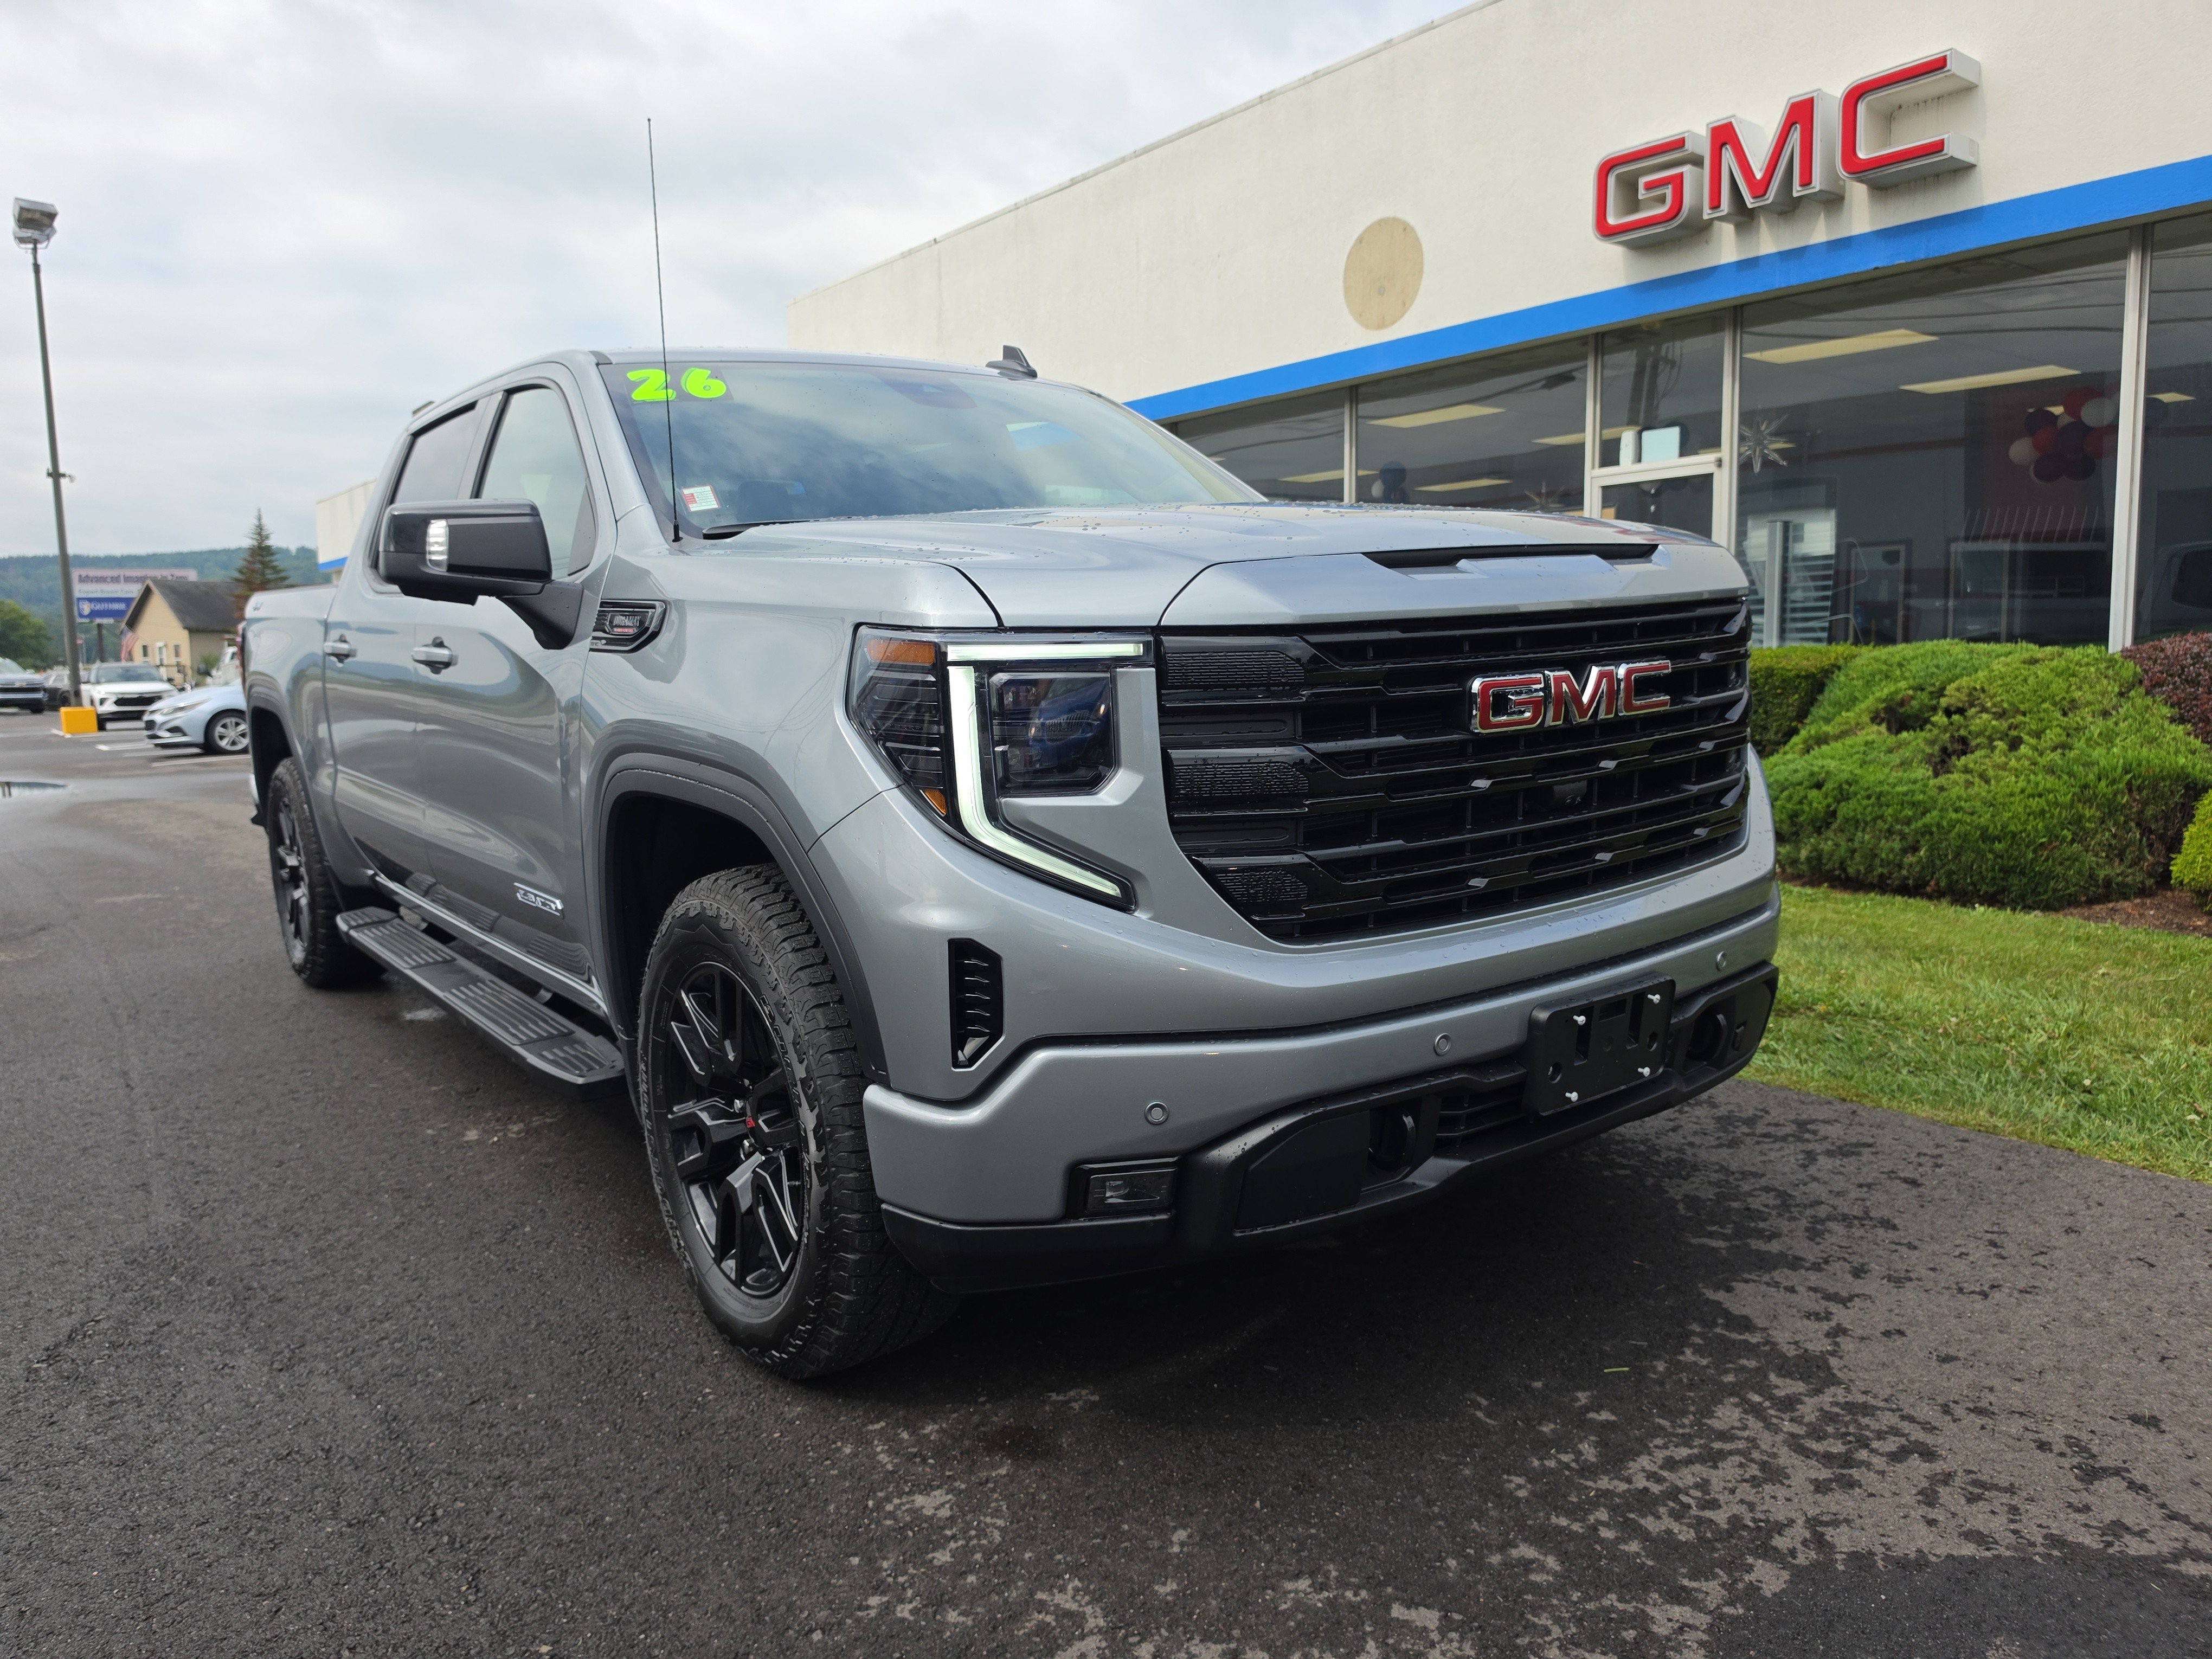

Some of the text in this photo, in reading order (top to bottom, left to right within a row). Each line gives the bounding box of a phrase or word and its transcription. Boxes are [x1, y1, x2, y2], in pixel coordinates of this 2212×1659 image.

[1593, 48, 1965, 244] GMC
[626, 368, 726, 402] 26
[78, 574, 121, 583] Advanced
[1471, 660, 1671, 734] GMC
